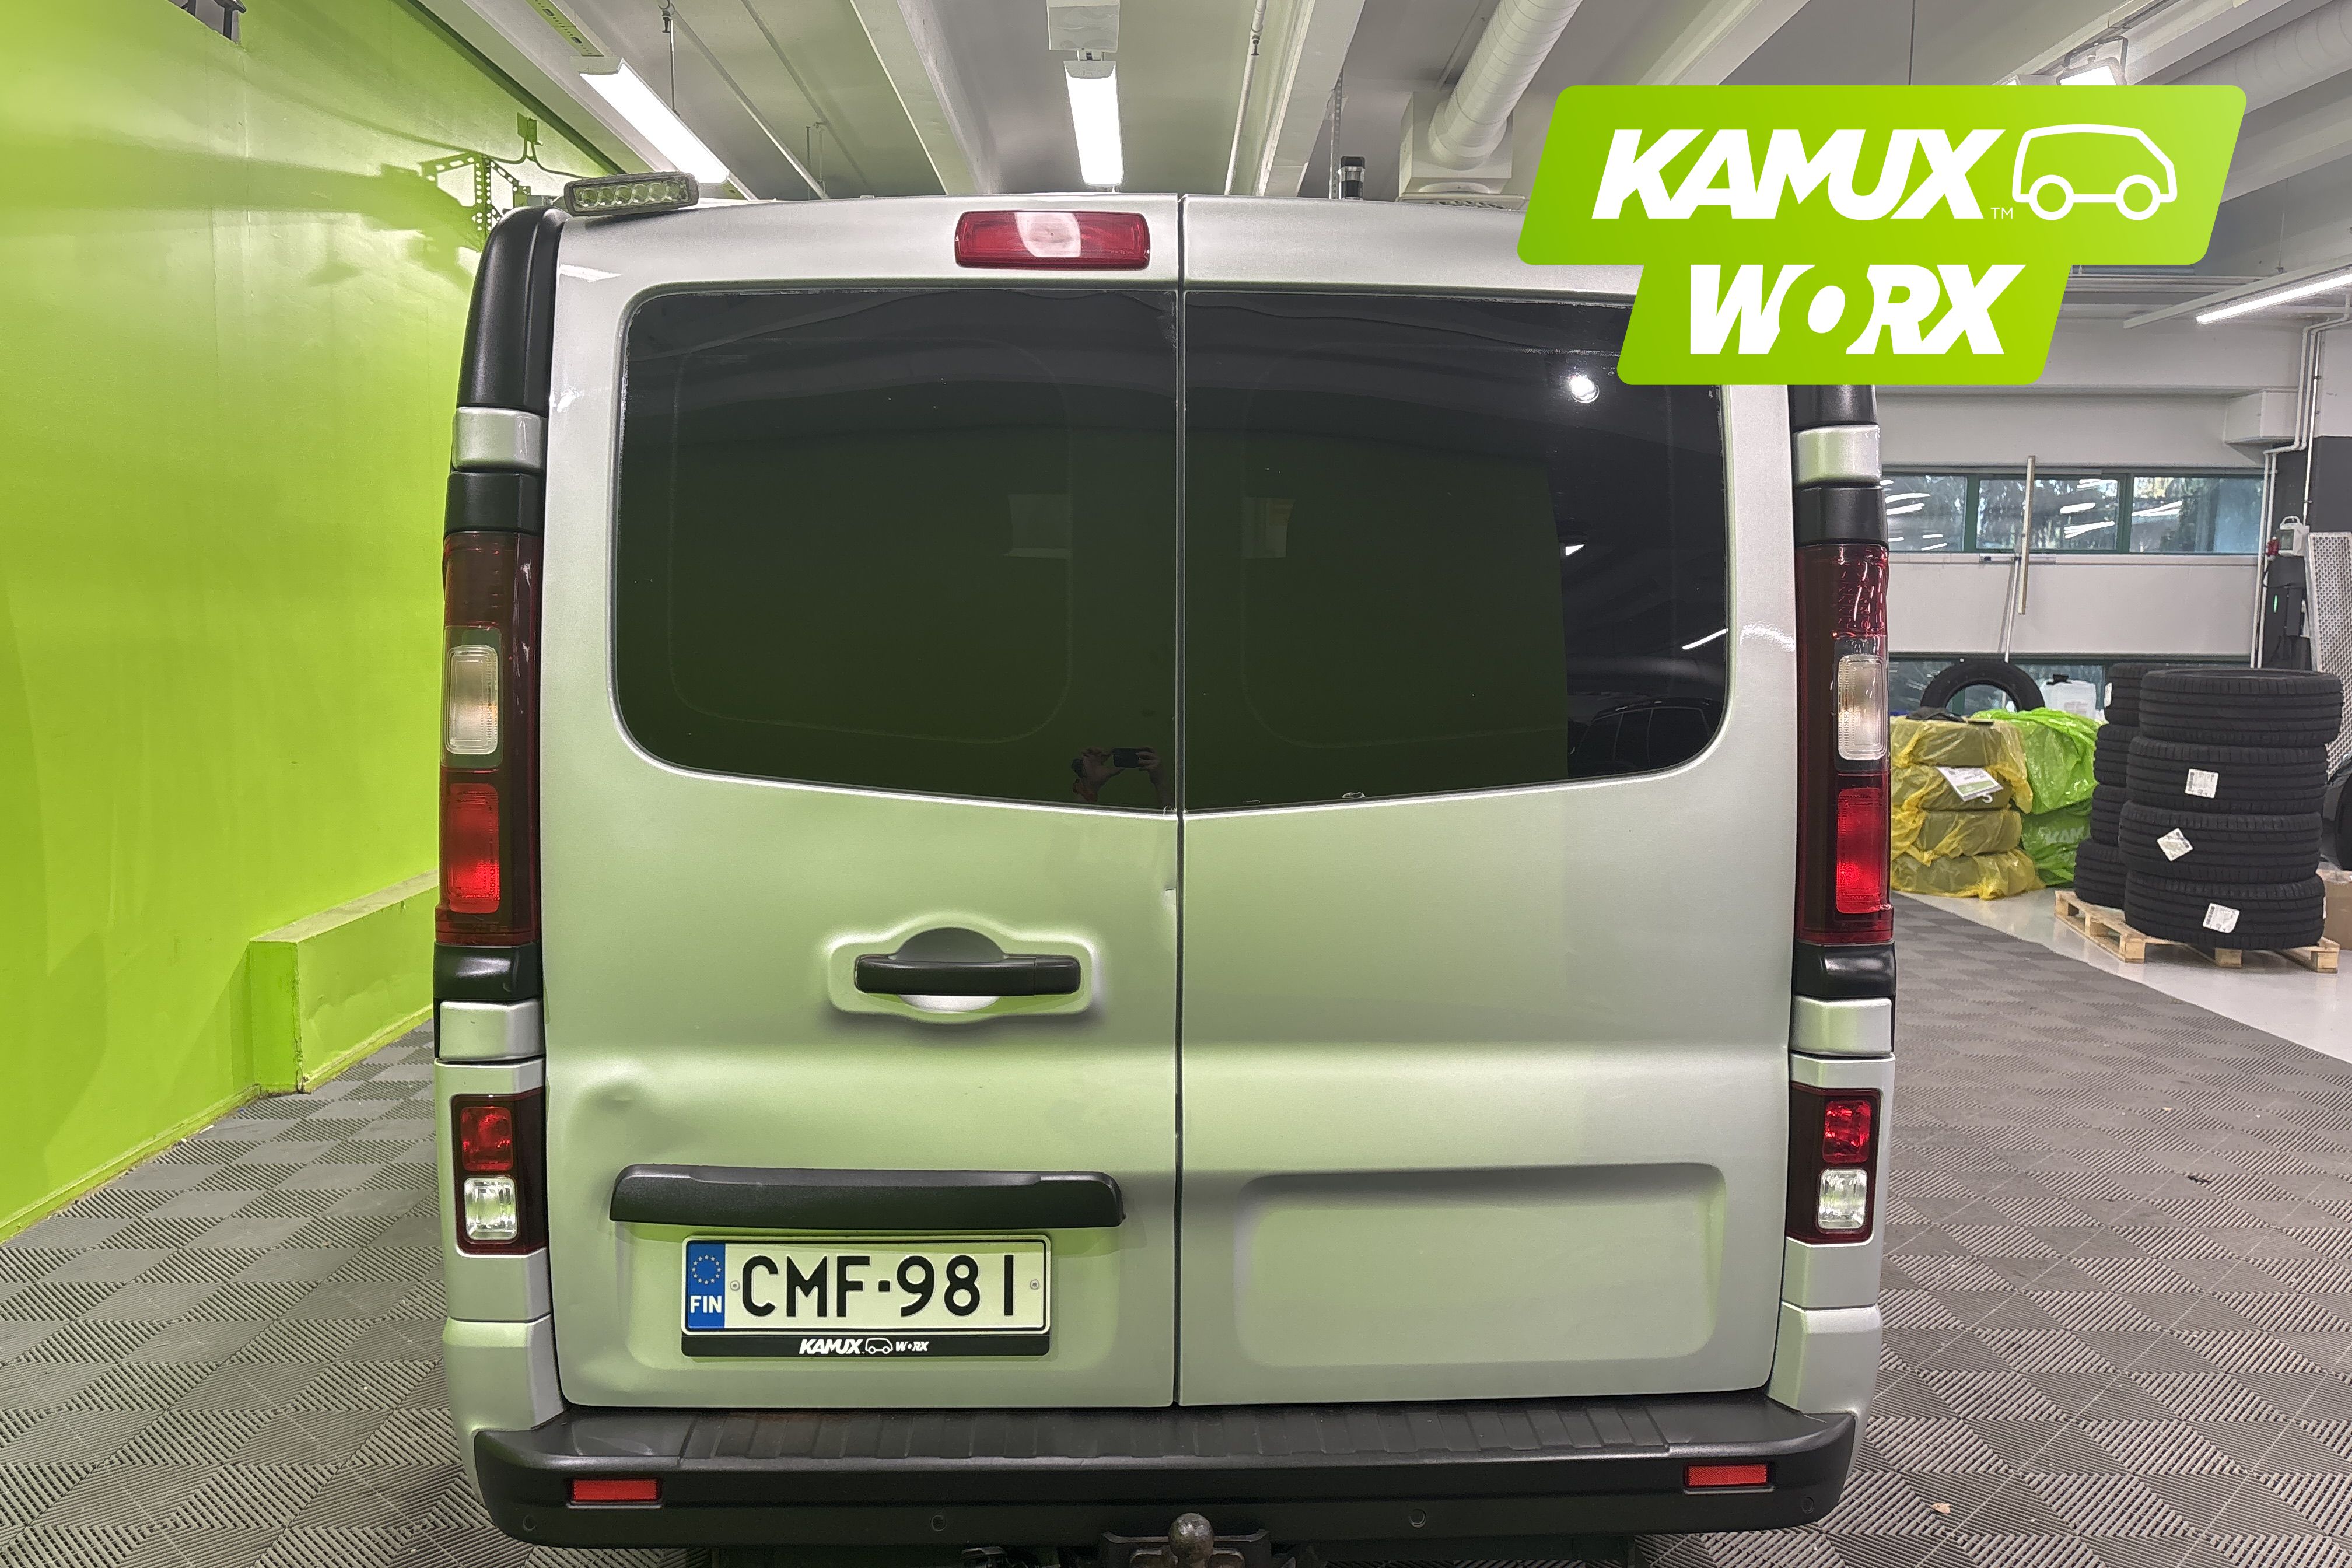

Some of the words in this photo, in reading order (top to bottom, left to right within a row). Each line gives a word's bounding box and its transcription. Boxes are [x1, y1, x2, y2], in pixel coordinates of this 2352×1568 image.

[742, 1254, 1014, 1317] CMF-981
[690, 1294, 722, 1314] FIN
[799, 1339, 863, 1354] KAMUX
[895, 1341, 930, 1352] WORX
